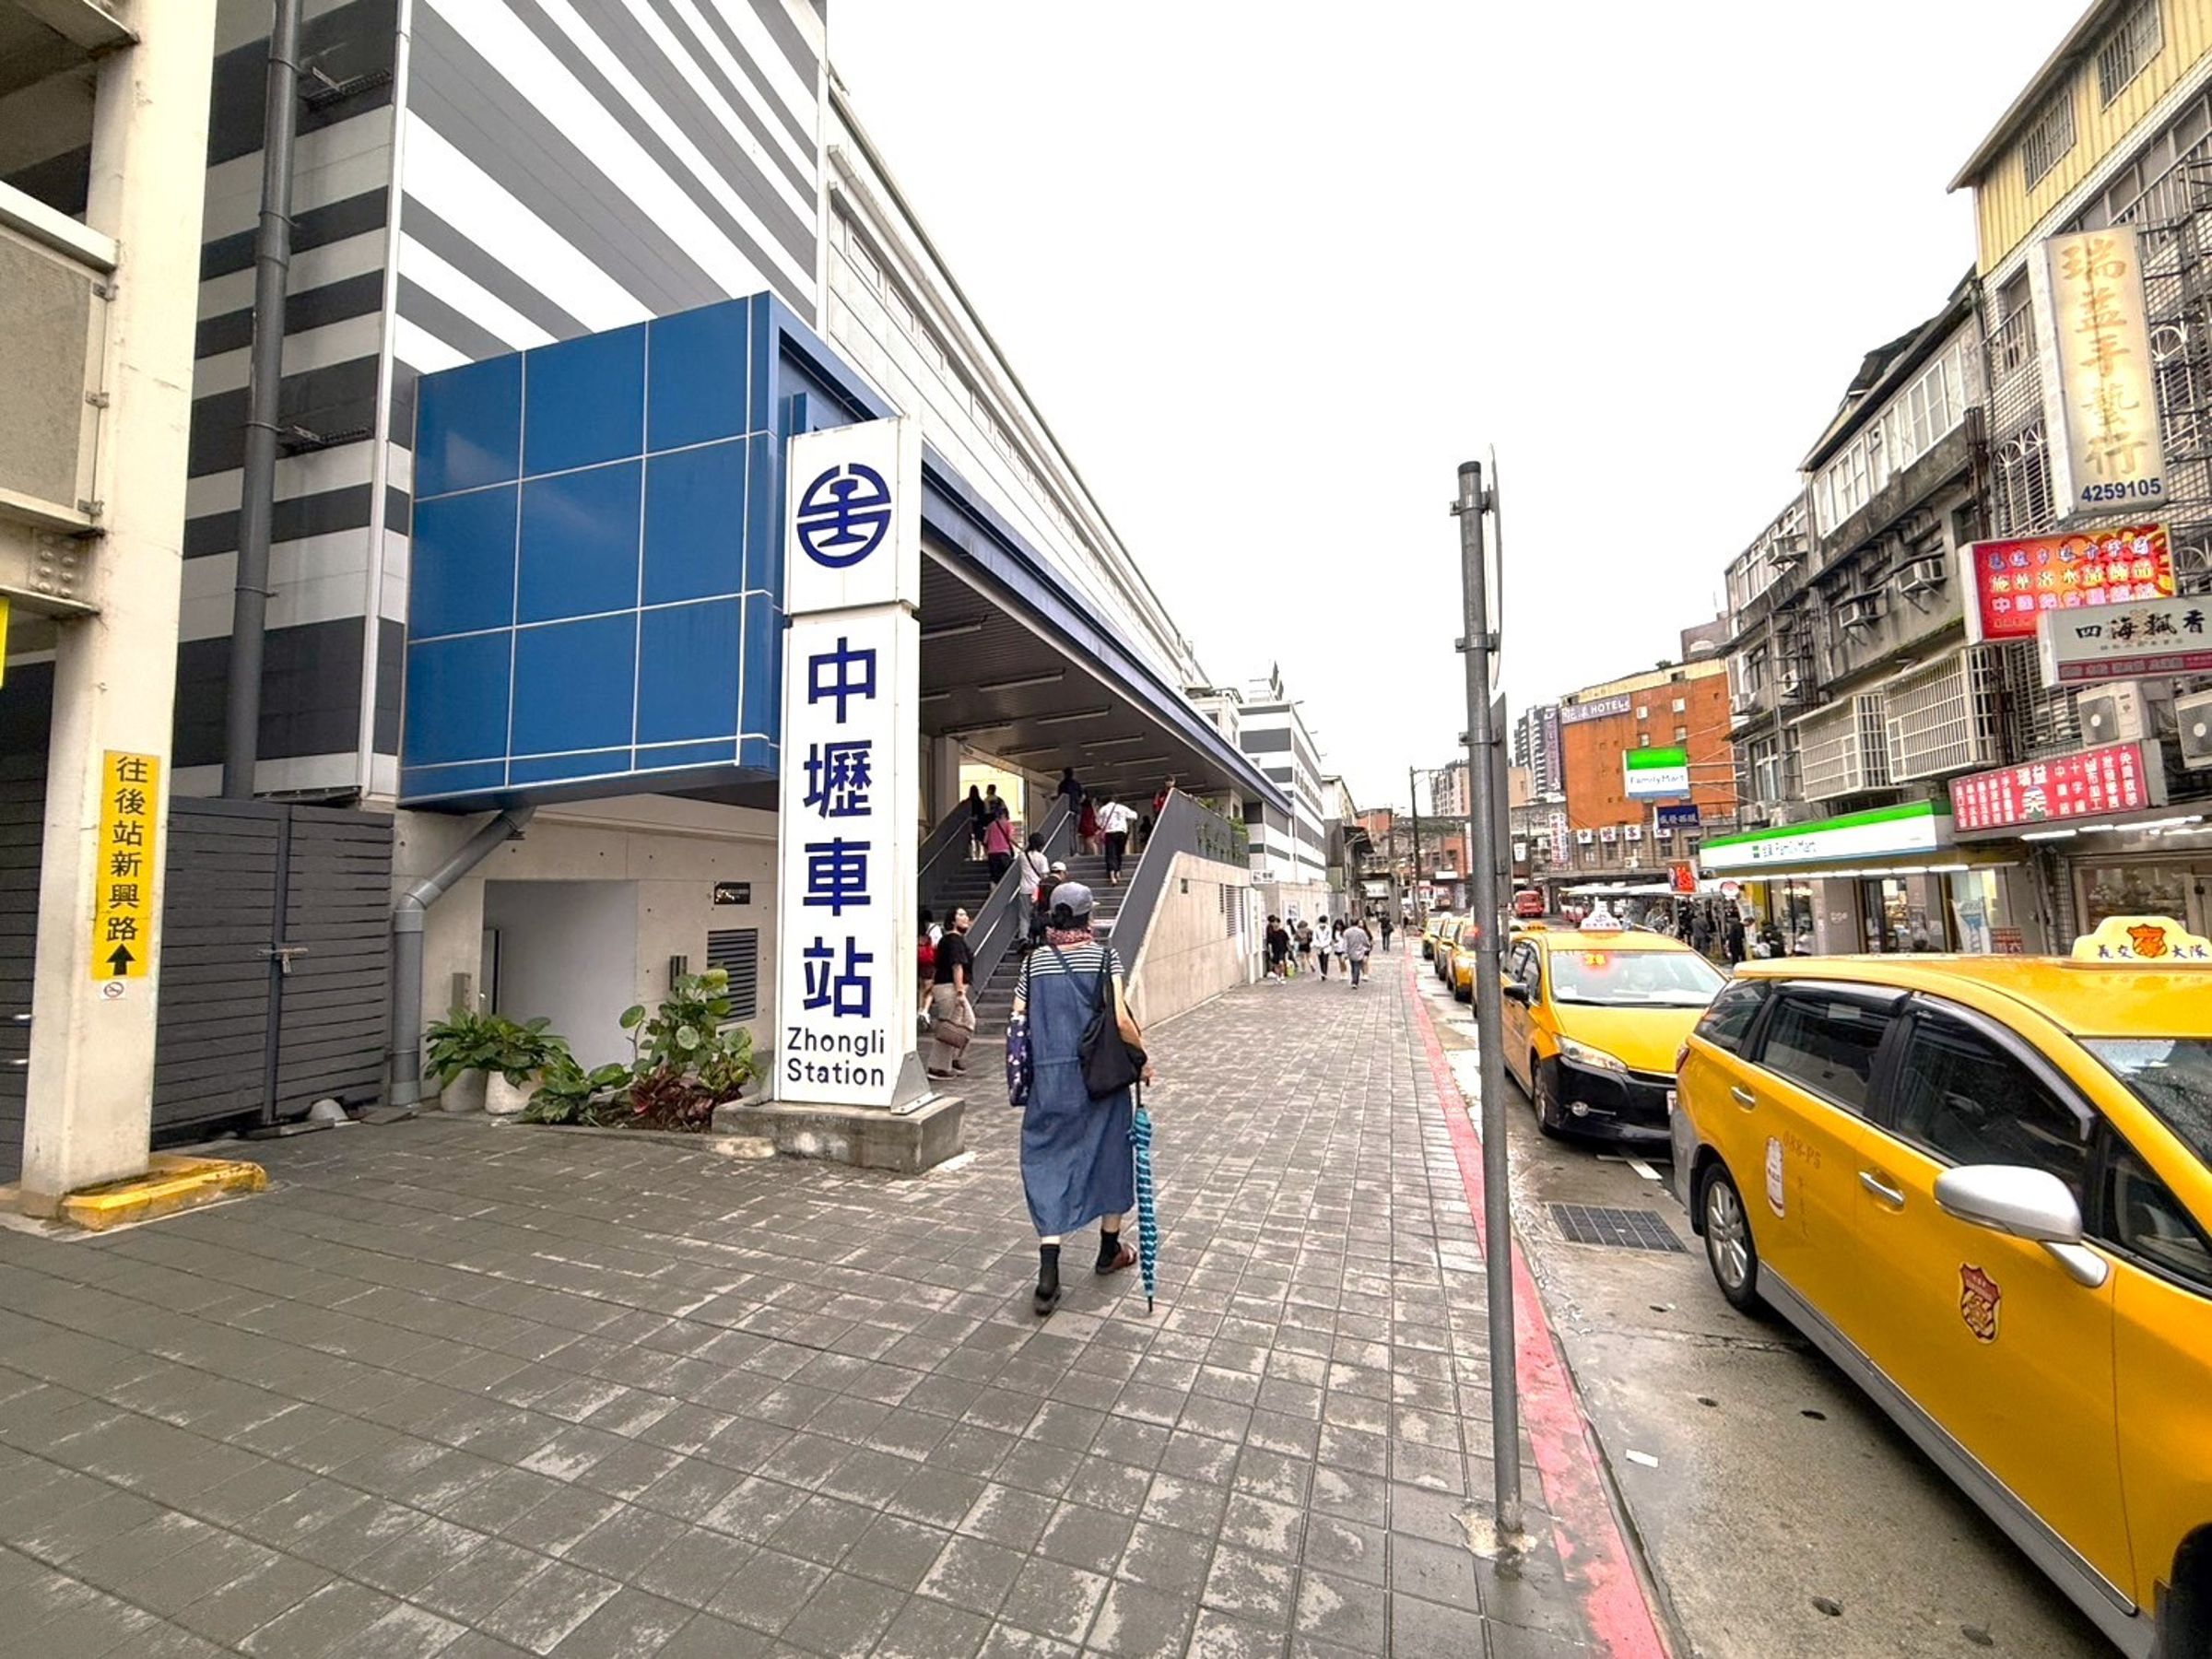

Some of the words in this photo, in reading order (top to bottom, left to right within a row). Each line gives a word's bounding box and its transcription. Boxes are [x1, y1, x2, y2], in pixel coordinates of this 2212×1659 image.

[2081, 477, 2161, 502] 4259105
[2076, 609, 2206, 640] 四海飄香
[1630, 774, 1685, 784] FamilyMart
[803, 637, 877, 1018] 中壢車站
[106, 756, 148, 942] 往後站新興路
[787, 1026, 885, 1057] Zhongli
[787, 1057, 885, 1087] Station
